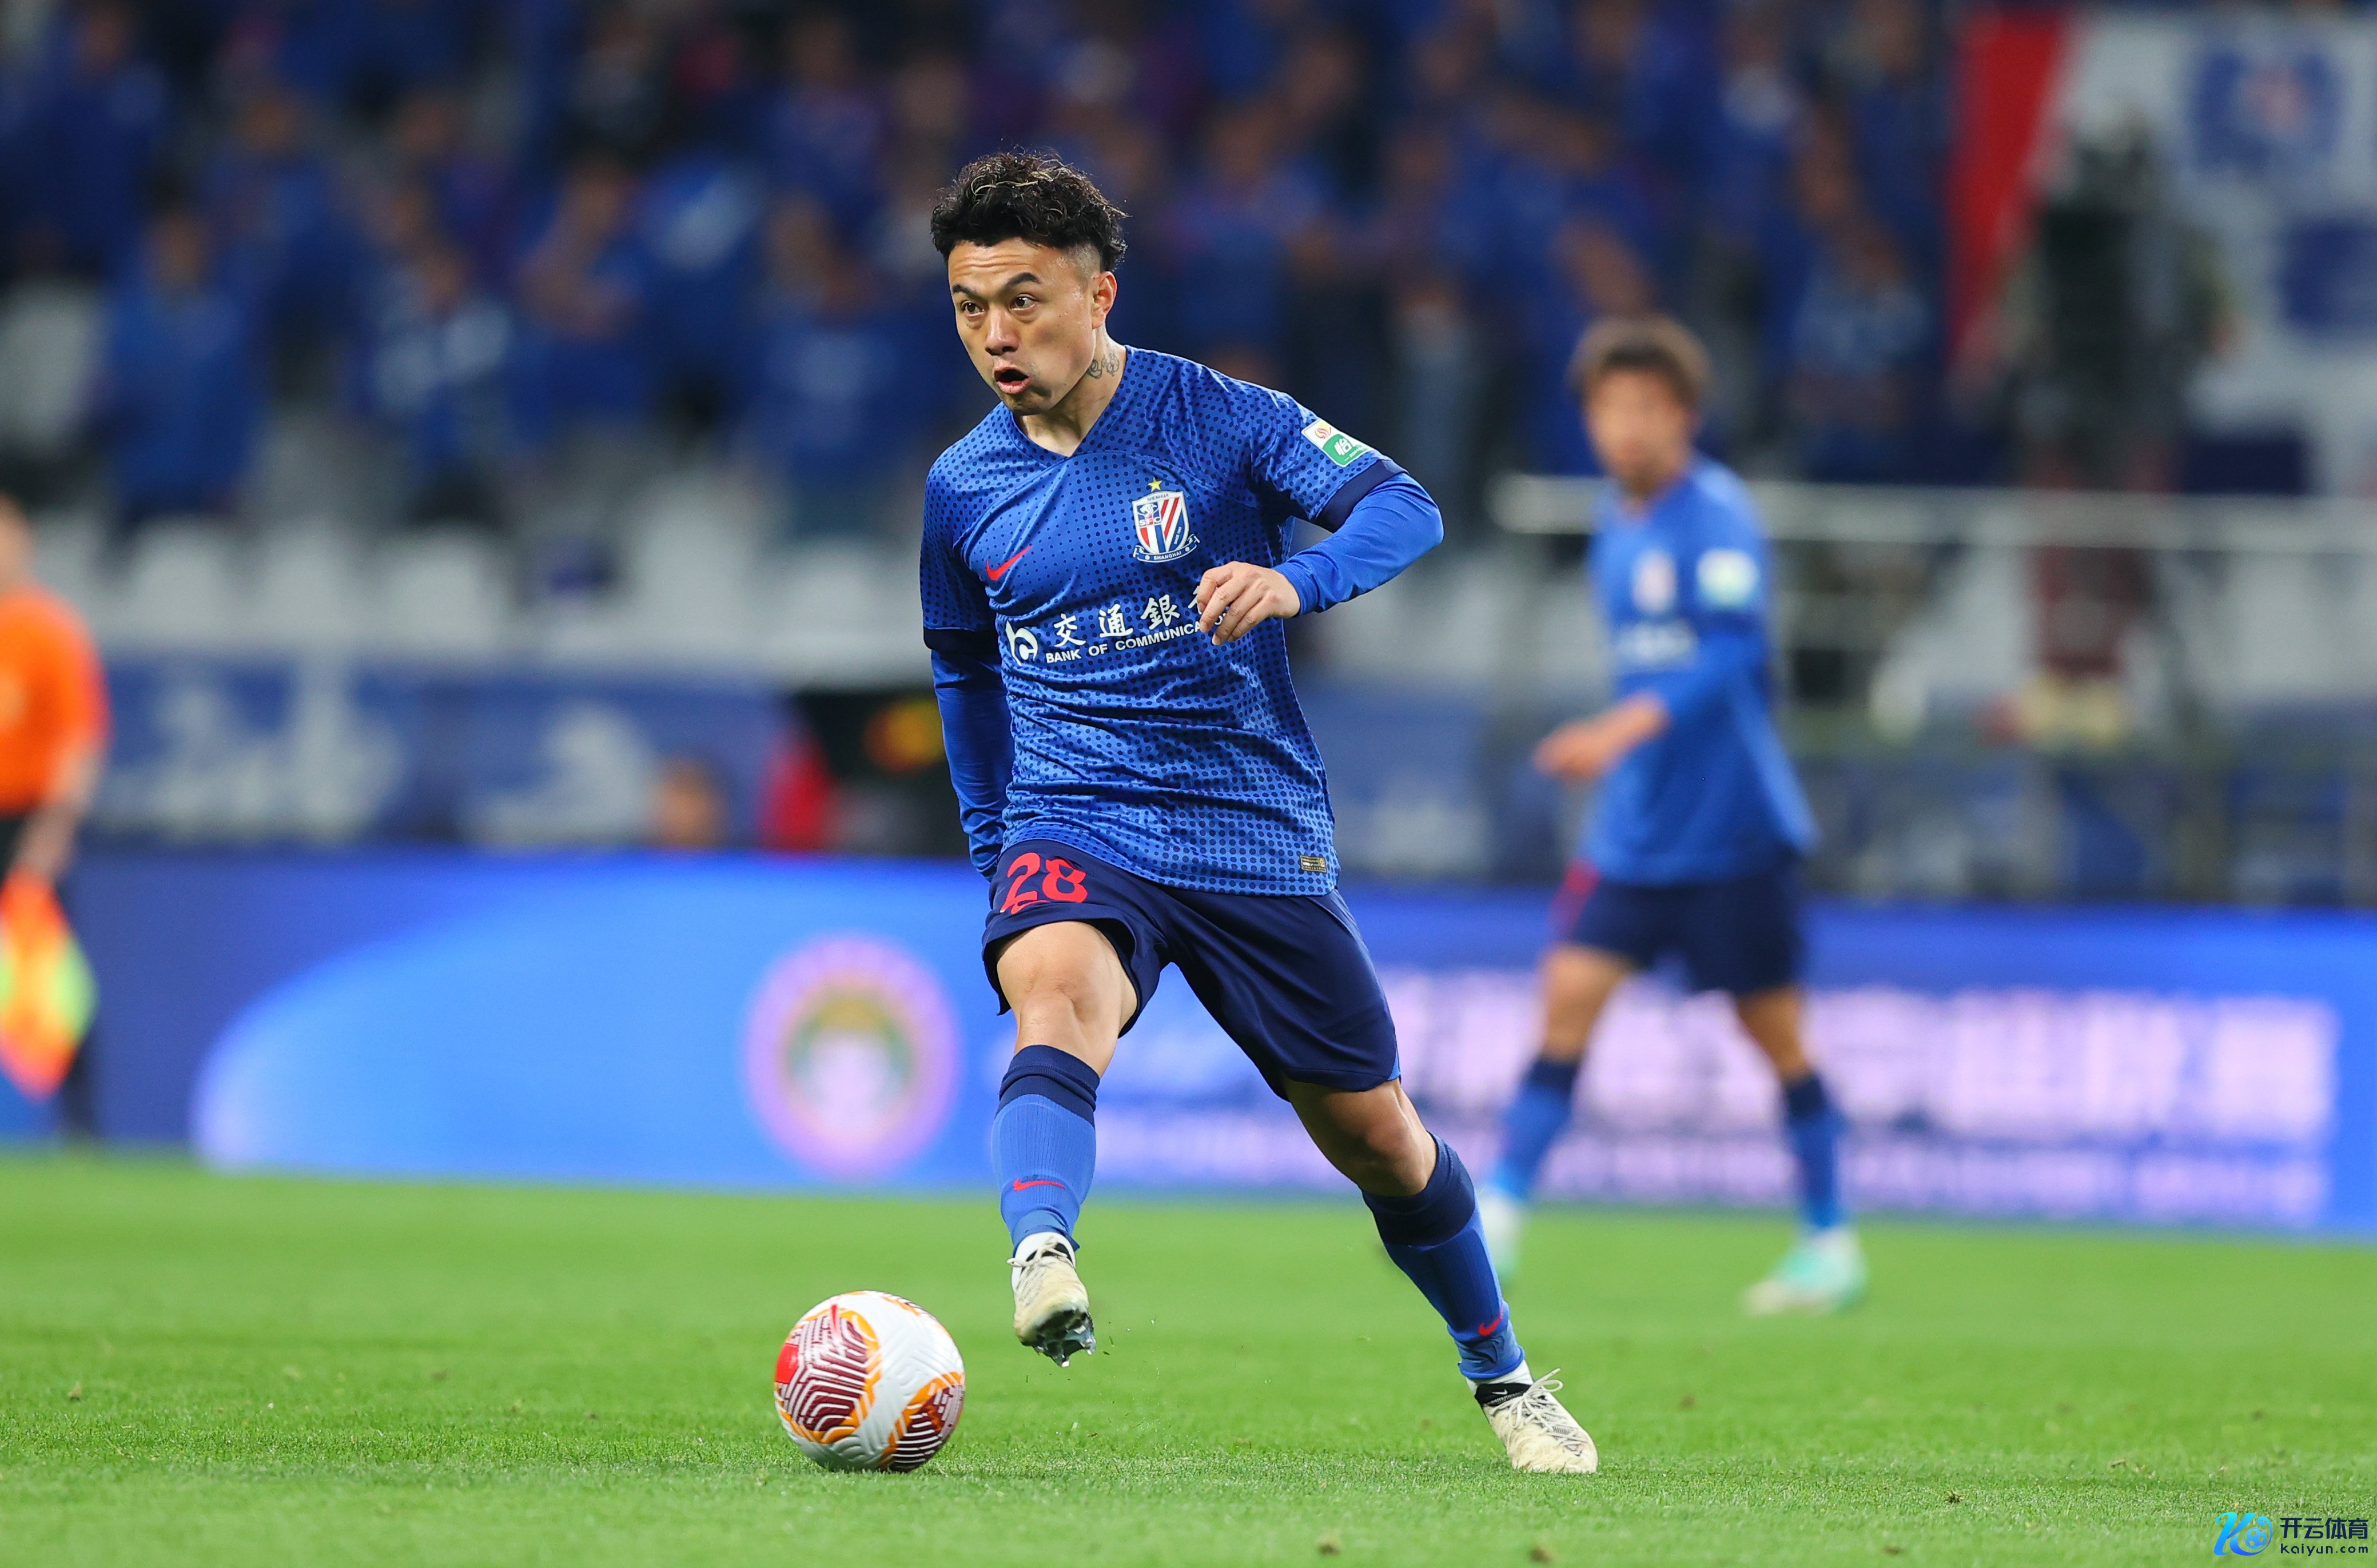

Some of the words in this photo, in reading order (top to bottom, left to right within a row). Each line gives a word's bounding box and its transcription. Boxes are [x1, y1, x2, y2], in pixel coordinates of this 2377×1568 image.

[1147, 493, 1169, 501] SHENHUA
[1139, 516, 1161, 527] SFC
[1153, 550, 1182, 560] SHANGHAI
[1045, 649, 1082, 664] BANK
[1088, 644, 1108, 656] OF
[1000, 852, 1088, 915] 28
